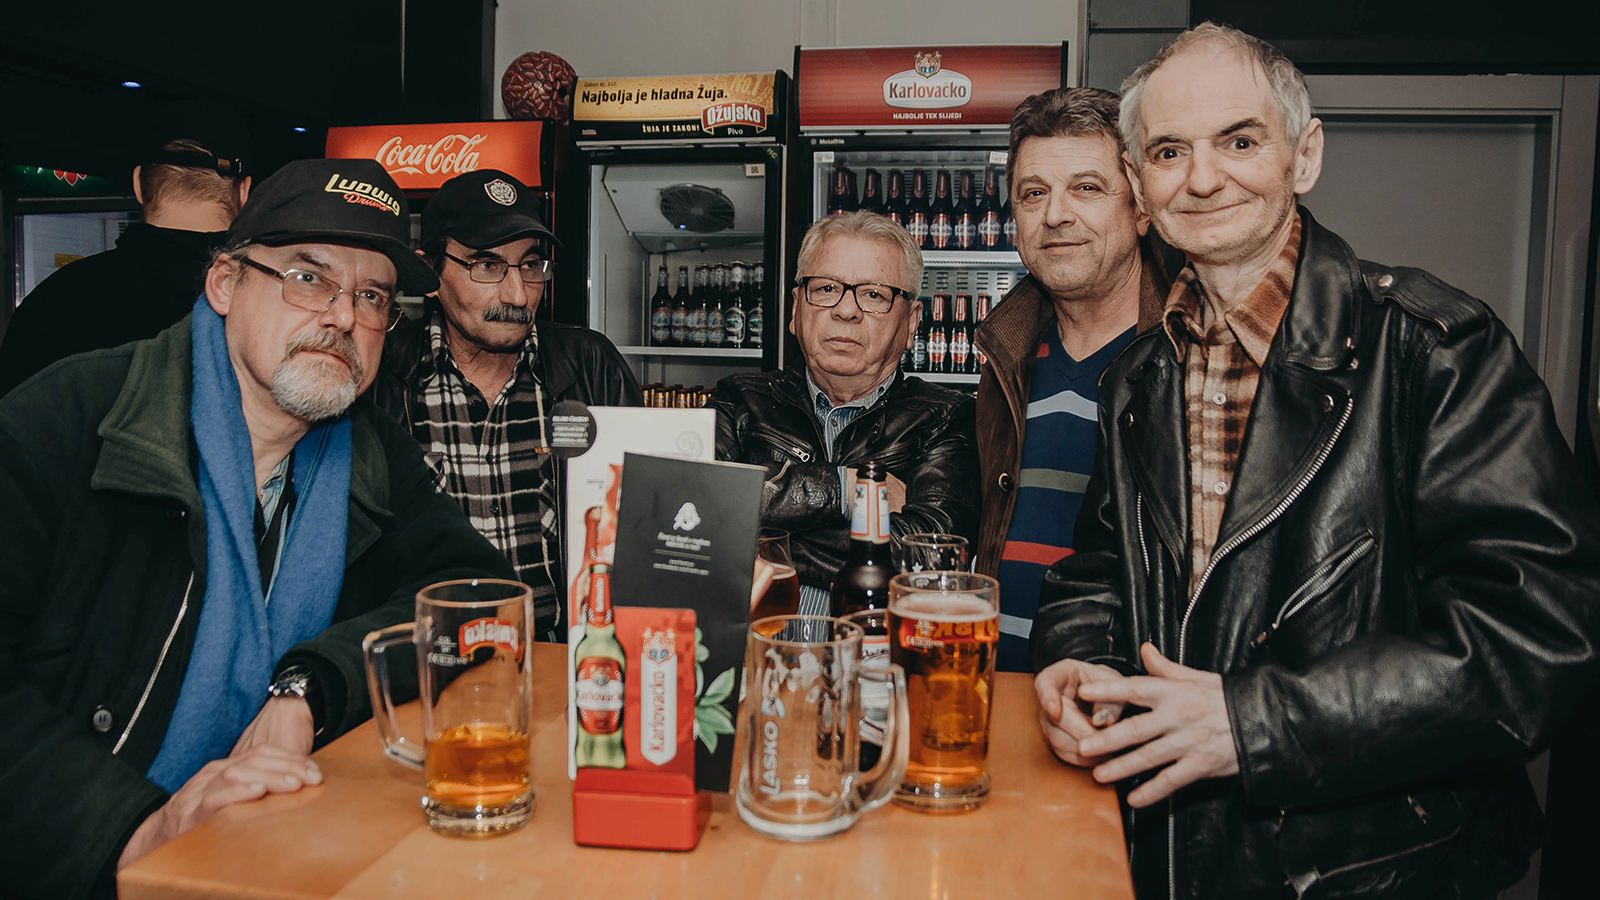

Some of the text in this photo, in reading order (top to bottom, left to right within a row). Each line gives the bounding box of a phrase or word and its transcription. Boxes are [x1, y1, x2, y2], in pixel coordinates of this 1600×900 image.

[581, 84, 728, 105] Najbolja je hladna Žuja.
[889, 82, 967, 99] Karlovačko
[706, 103, 761, 126] Ožujsko
[642, 124, 660, 133] ŽUJA
[672, 124, 700, 132] ZAKON!
[727, 127, 744, 135] Pivo
[375, 133, 488, 176] Coca-Cola
